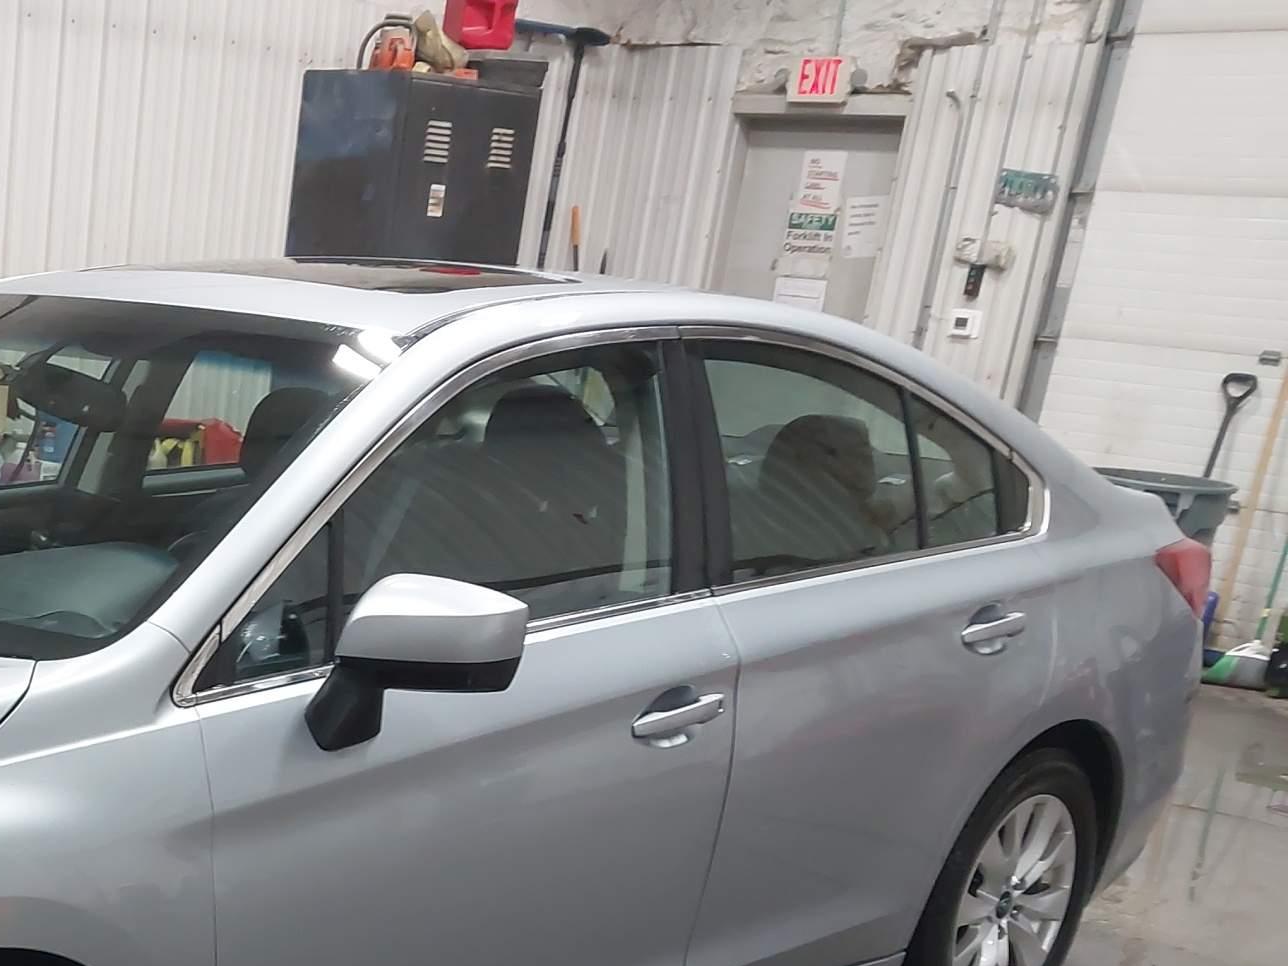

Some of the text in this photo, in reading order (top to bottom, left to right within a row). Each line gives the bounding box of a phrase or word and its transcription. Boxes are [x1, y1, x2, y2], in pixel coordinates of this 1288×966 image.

[798, 59, 842, 95] EXIT
[791, 214, 835, 225] SAFETY
[786, 231, 821, 241] Forklift
[783, 242, 832, 254] Operation
